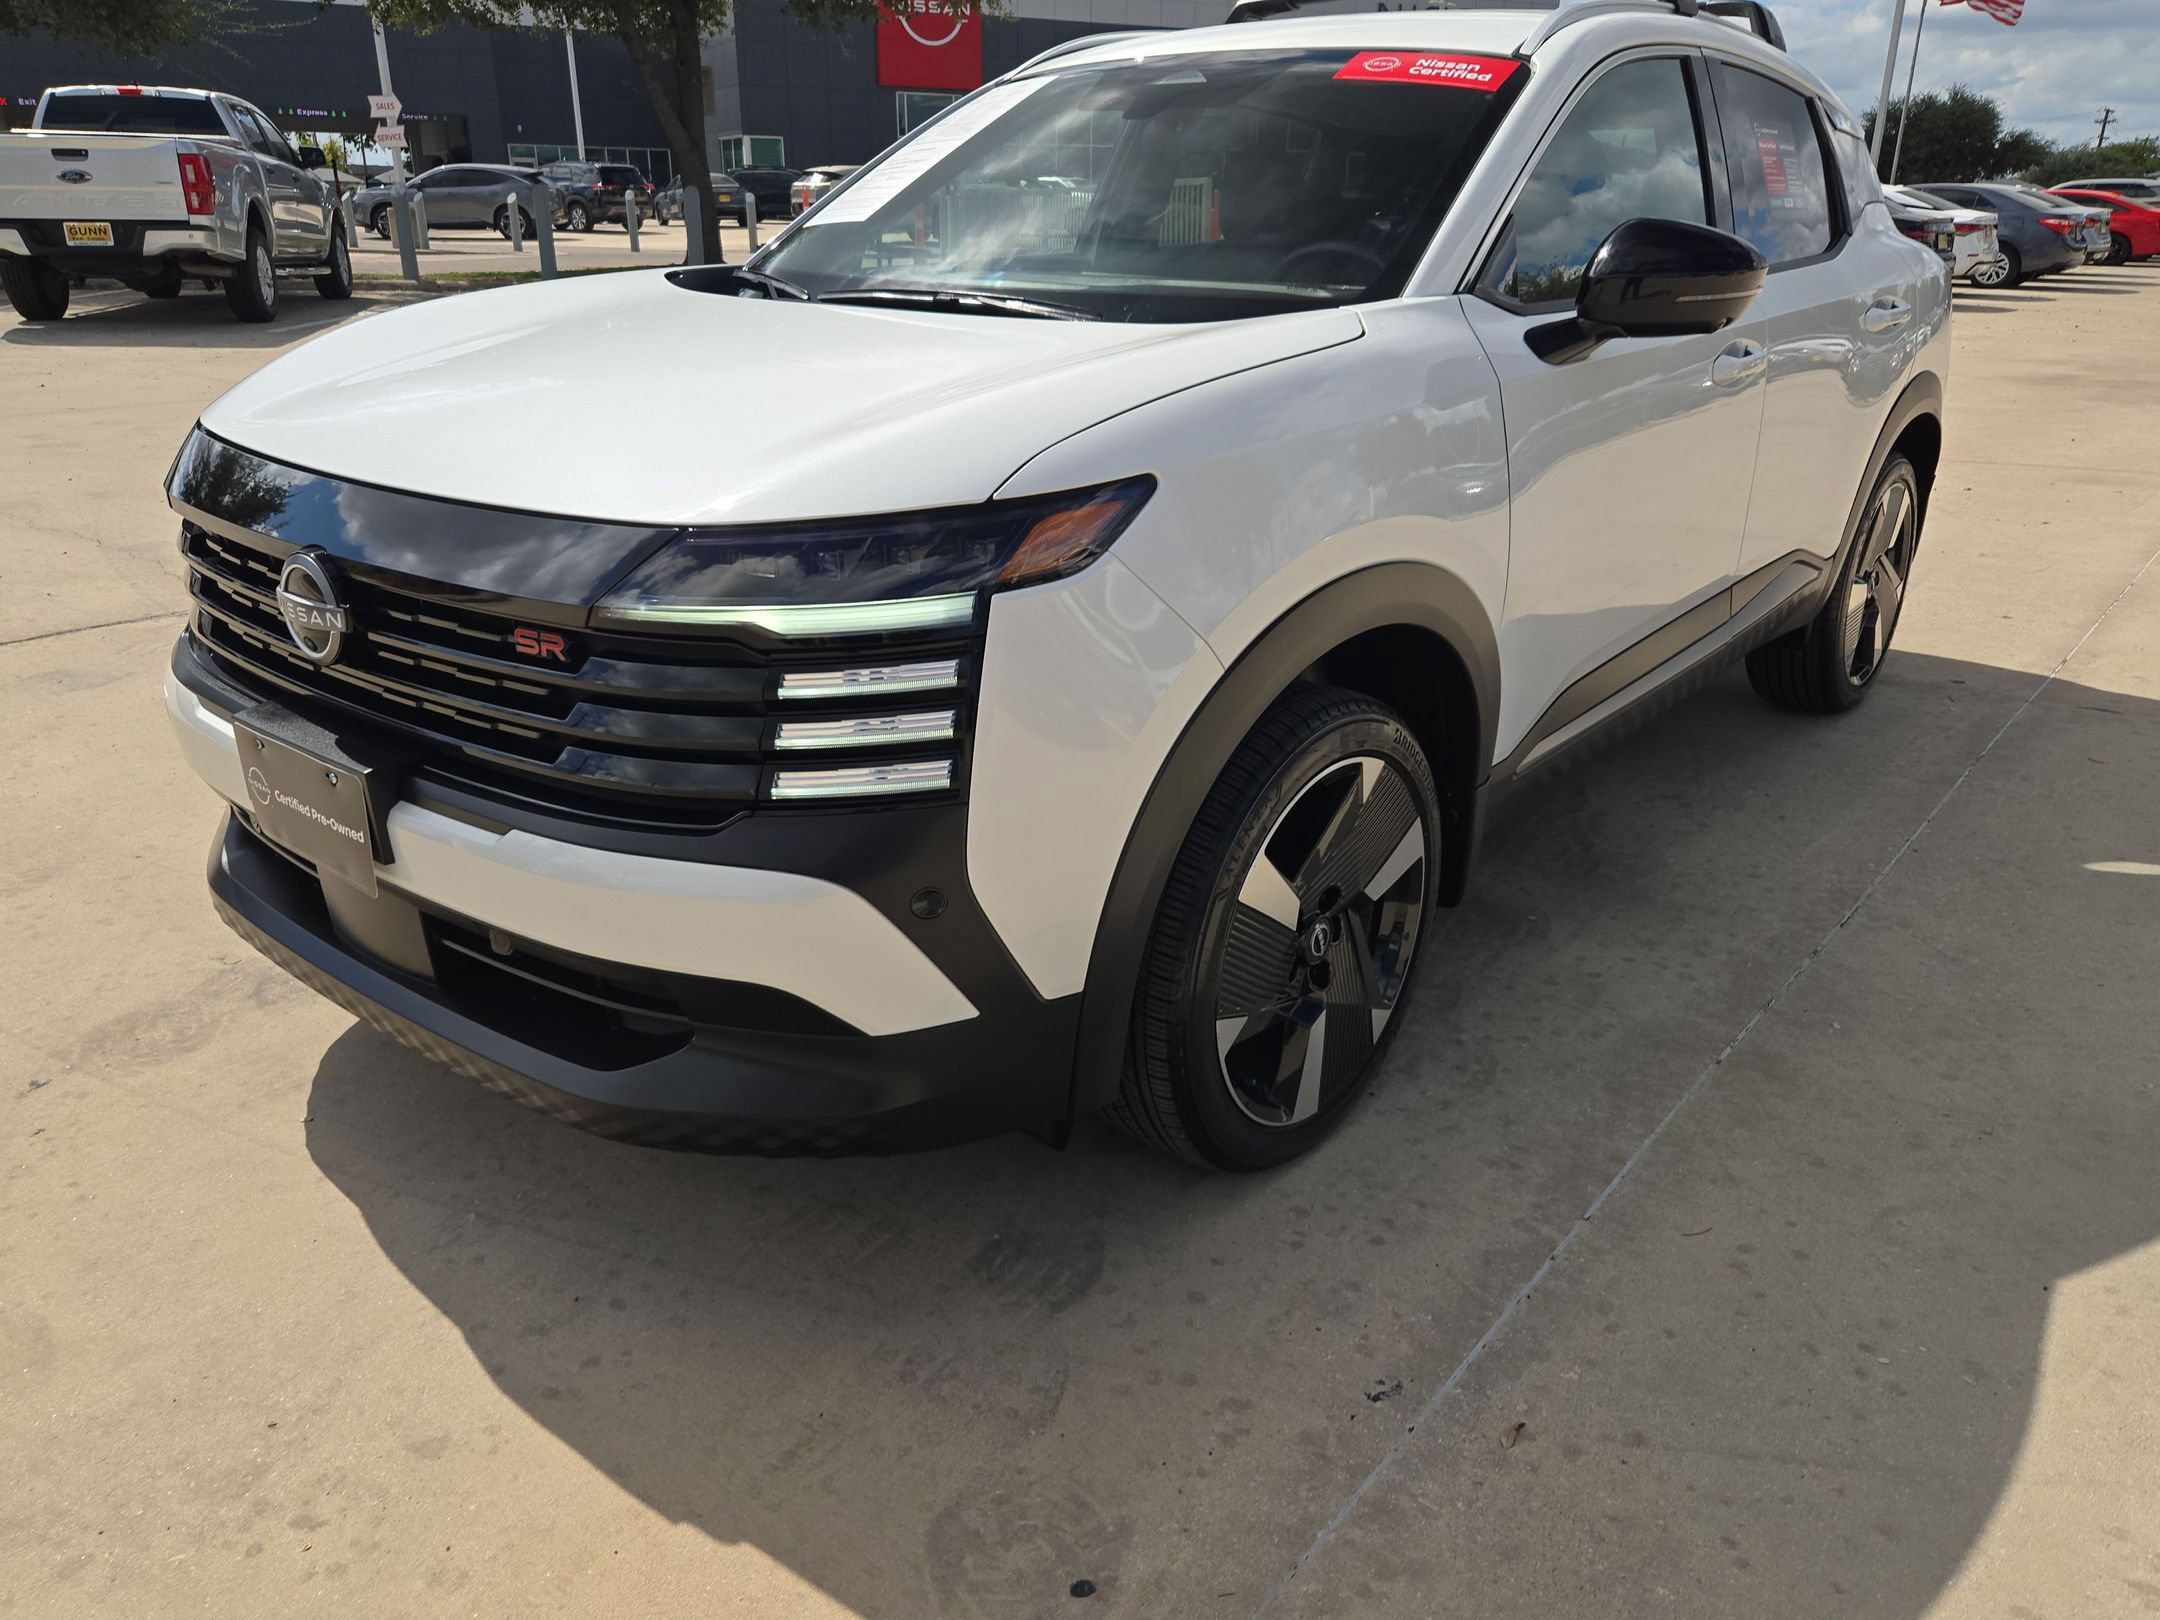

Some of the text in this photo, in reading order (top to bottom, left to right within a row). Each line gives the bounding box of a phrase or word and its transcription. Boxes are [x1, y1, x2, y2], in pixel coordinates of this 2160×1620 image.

[1416, 58, 1481, 71] Nissan
[1409, 66, 1492, 82] Certified
[18, 98, 37, 106] Exit
[376, 102, 395, 110] SALES
[296, 108, 328, 117] Express
[377, 133, 401, 142] SERVICE
[69, 227, 107, 236] GUNN
[513, 627, 567, 662] SR
[274, 790, 365, 843] Certified Pre-Owned
